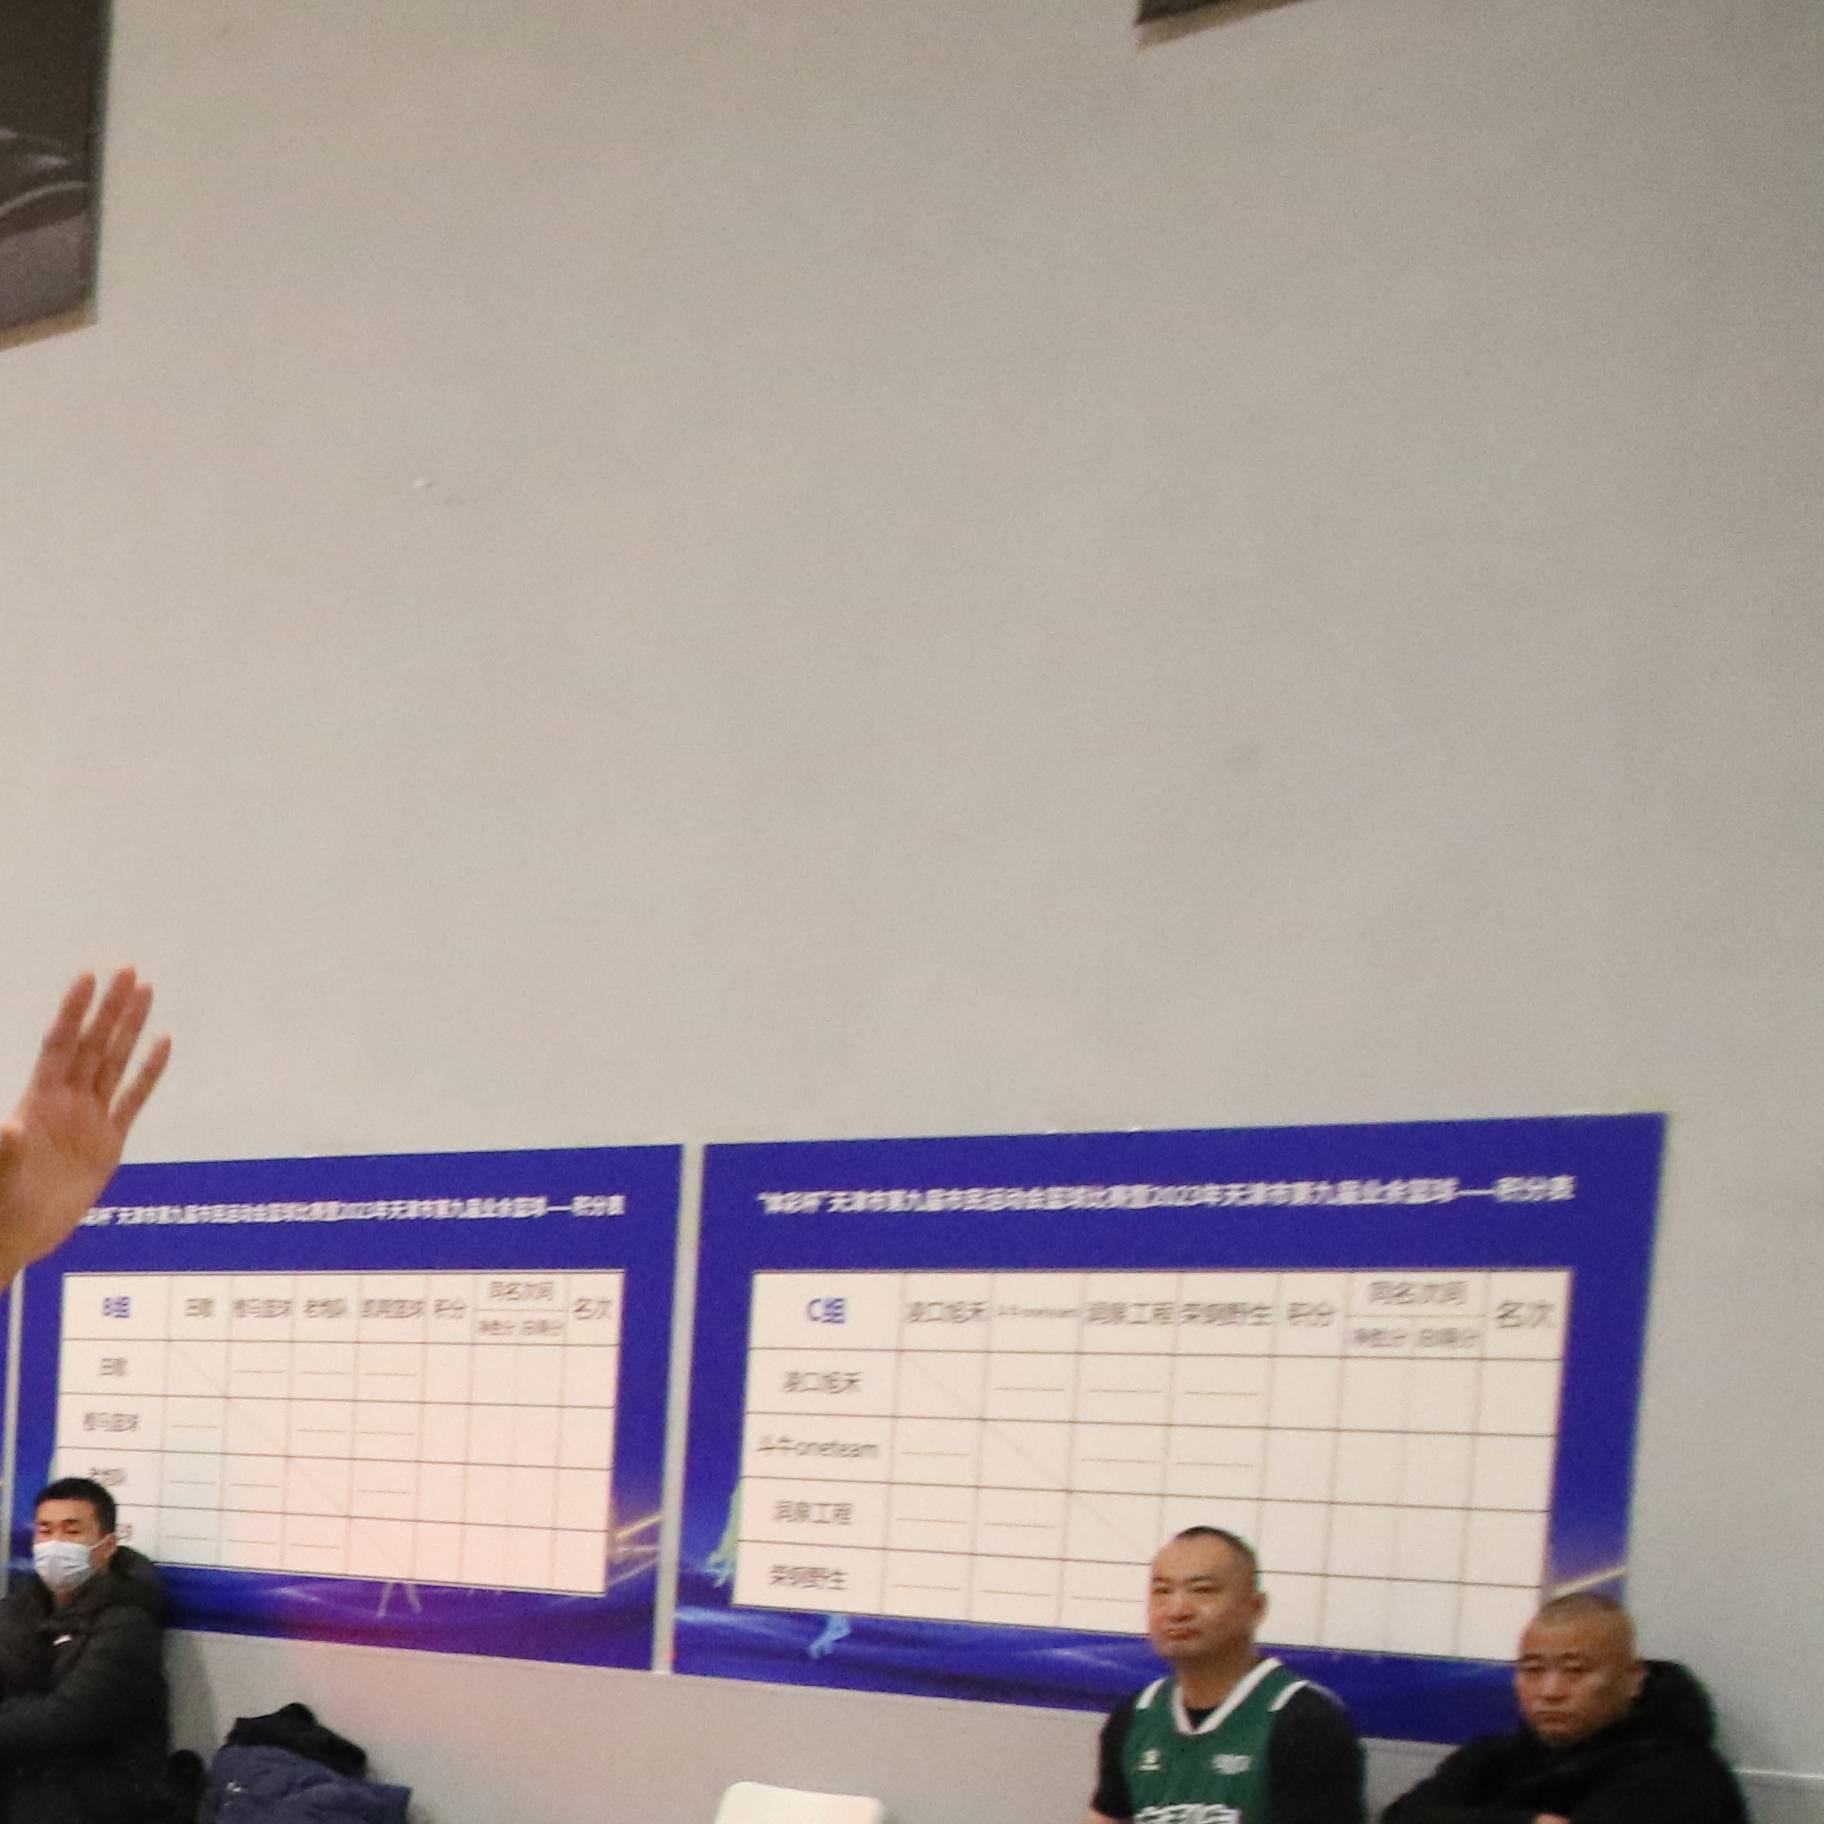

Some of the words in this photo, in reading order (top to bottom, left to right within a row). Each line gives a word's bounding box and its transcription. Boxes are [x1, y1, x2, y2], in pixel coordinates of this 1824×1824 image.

[573, 1300, 613, 1322] 名次
[806, 1297, 847, 1325] C组
[1288, 1302, 1335, 1328] 积分
[1495, 1300, 1556, 1329] 名次
